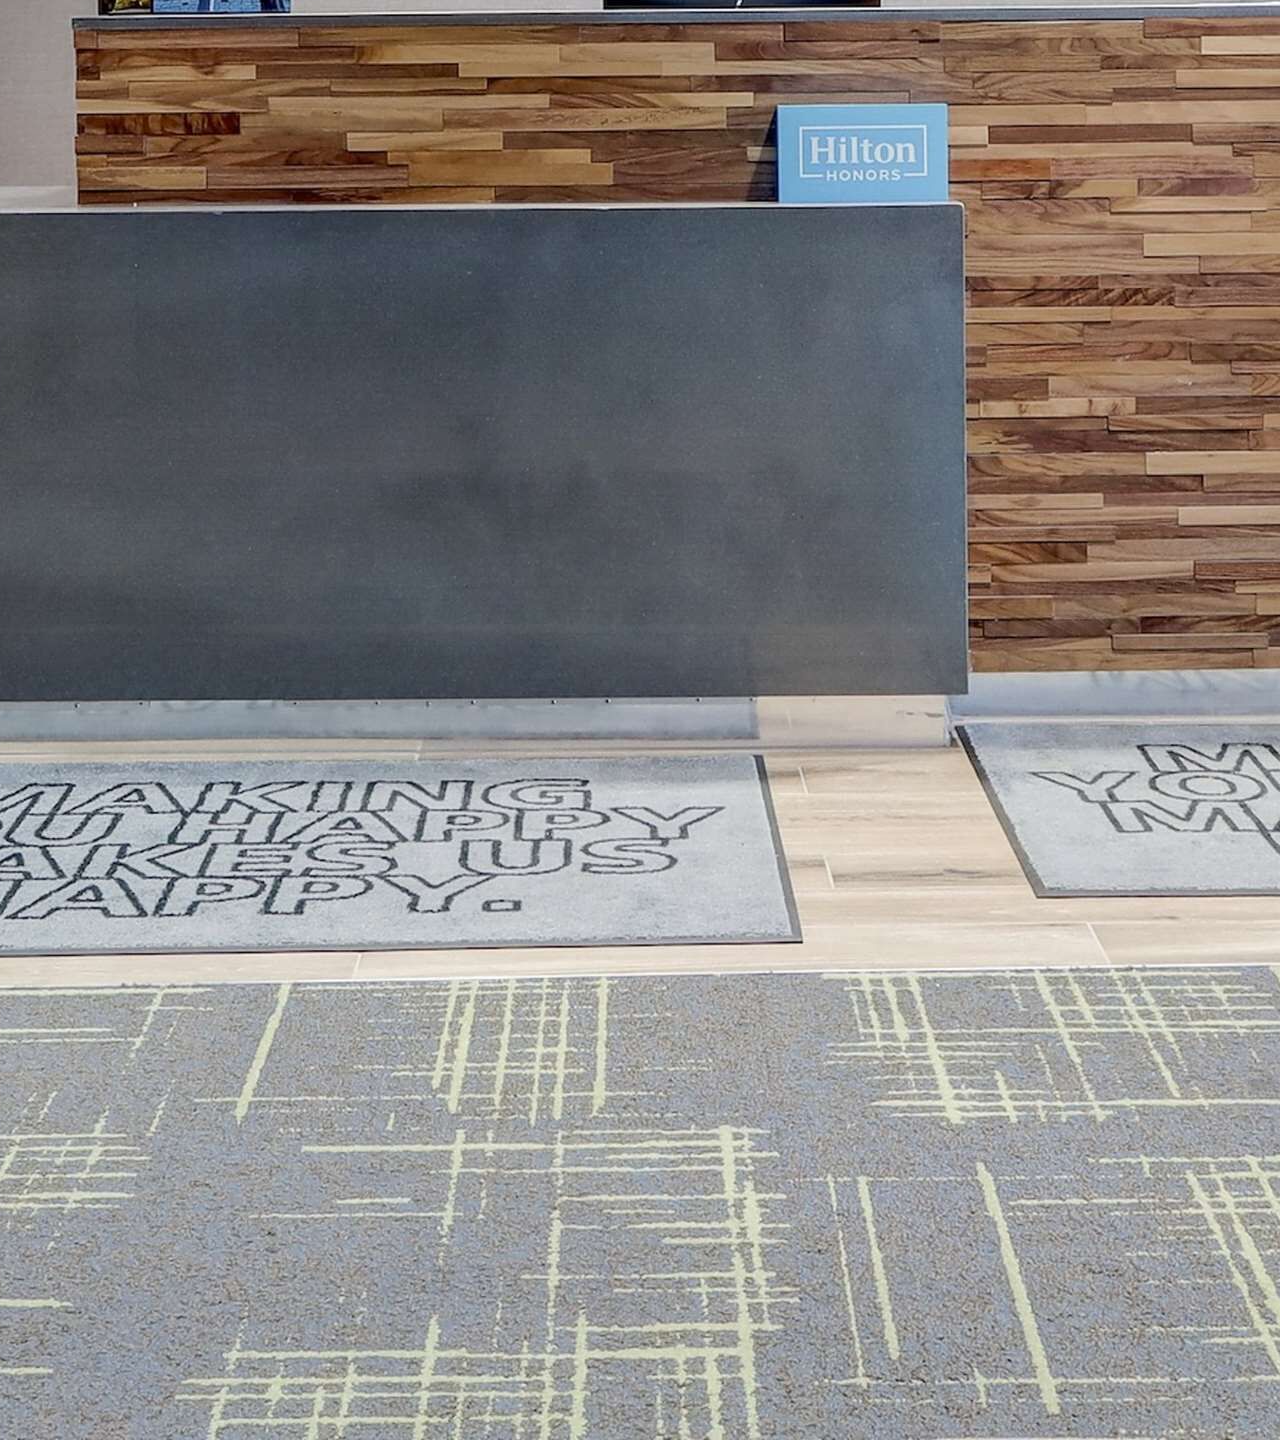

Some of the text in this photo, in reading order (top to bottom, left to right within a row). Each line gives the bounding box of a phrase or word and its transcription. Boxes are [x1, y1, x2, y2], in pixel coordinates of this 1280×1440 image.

[809, 136, 917, 165] Hilton
[826, 169, 902, 182] HONORS
[184, 806, 728, 844] HAPPY
[459, 838, 681, 877] US
